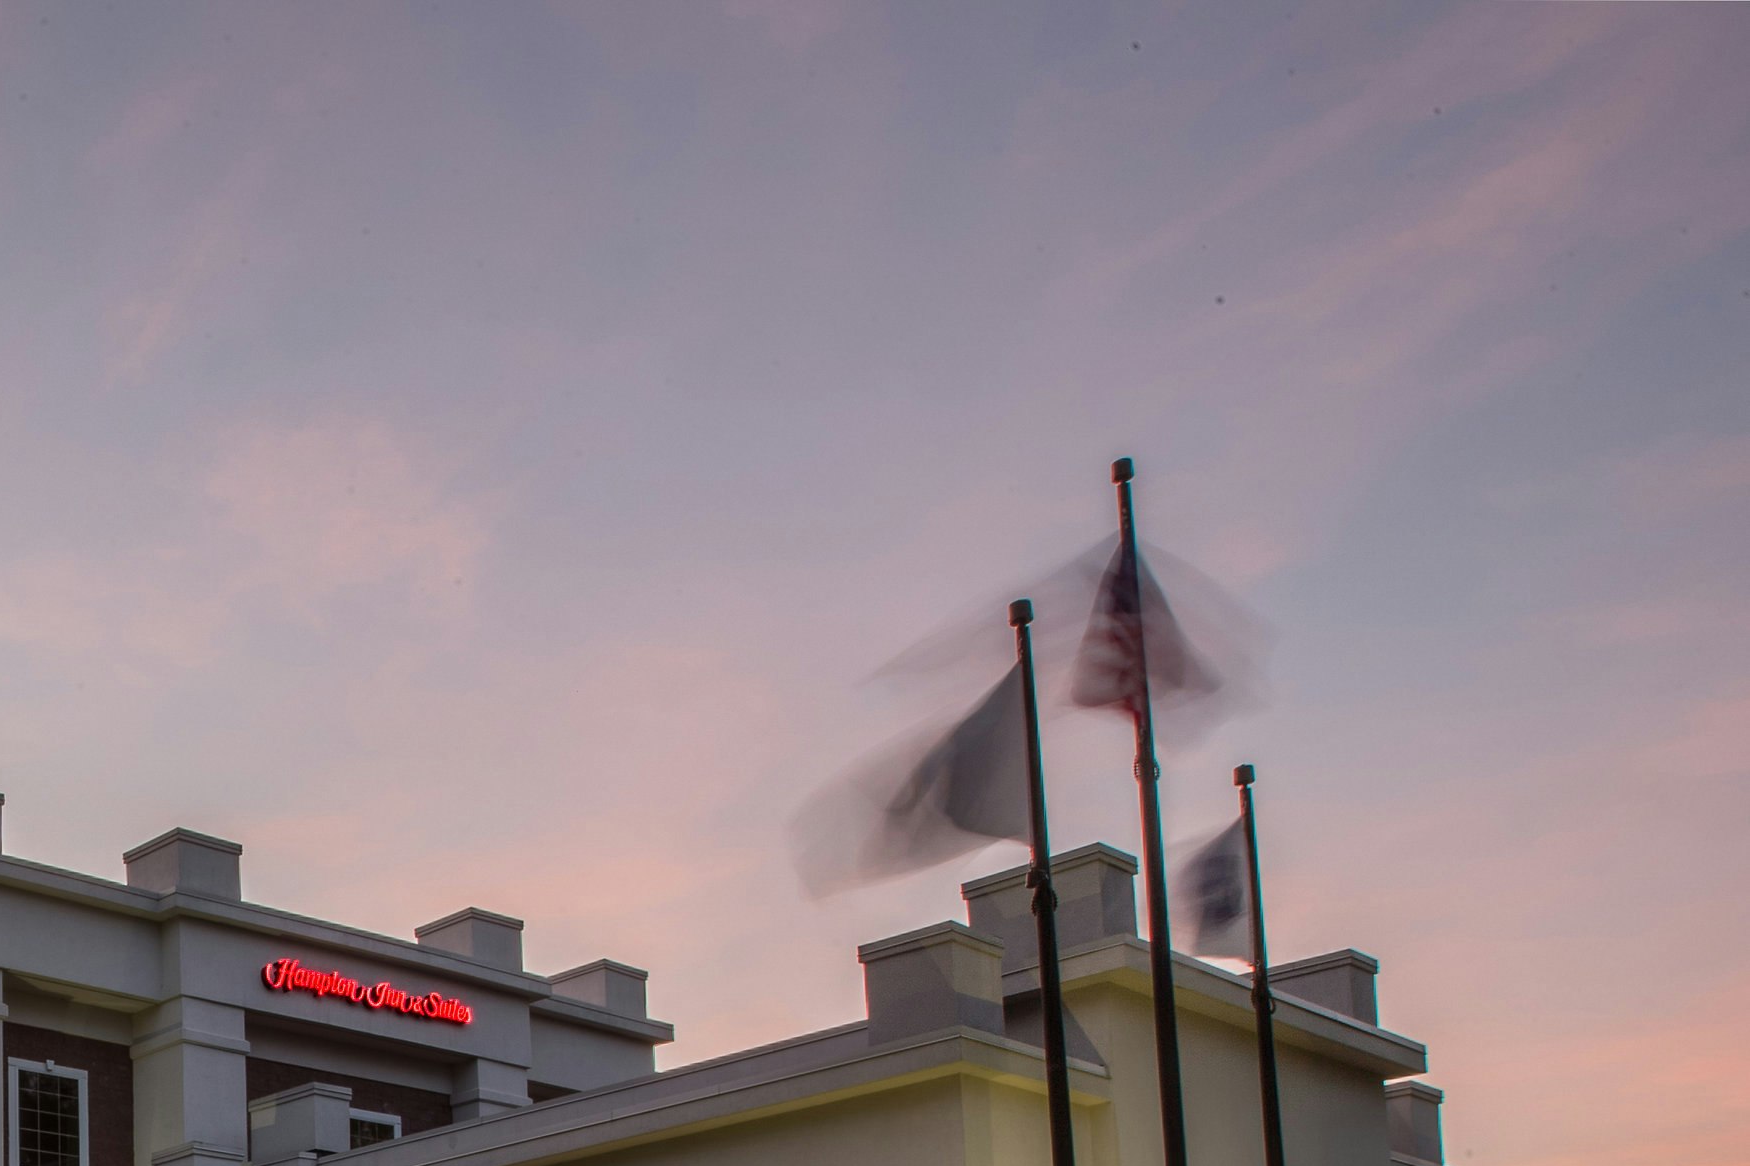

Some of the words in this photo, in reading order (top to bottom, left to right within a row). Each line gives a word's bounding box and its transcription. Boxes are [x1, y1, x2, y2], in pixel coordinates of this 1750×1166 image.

[263, 957, 365, 1003] Hampton
[365, 981, 414, 1013] Inn
[423, 991, 473, 1025] Suites
